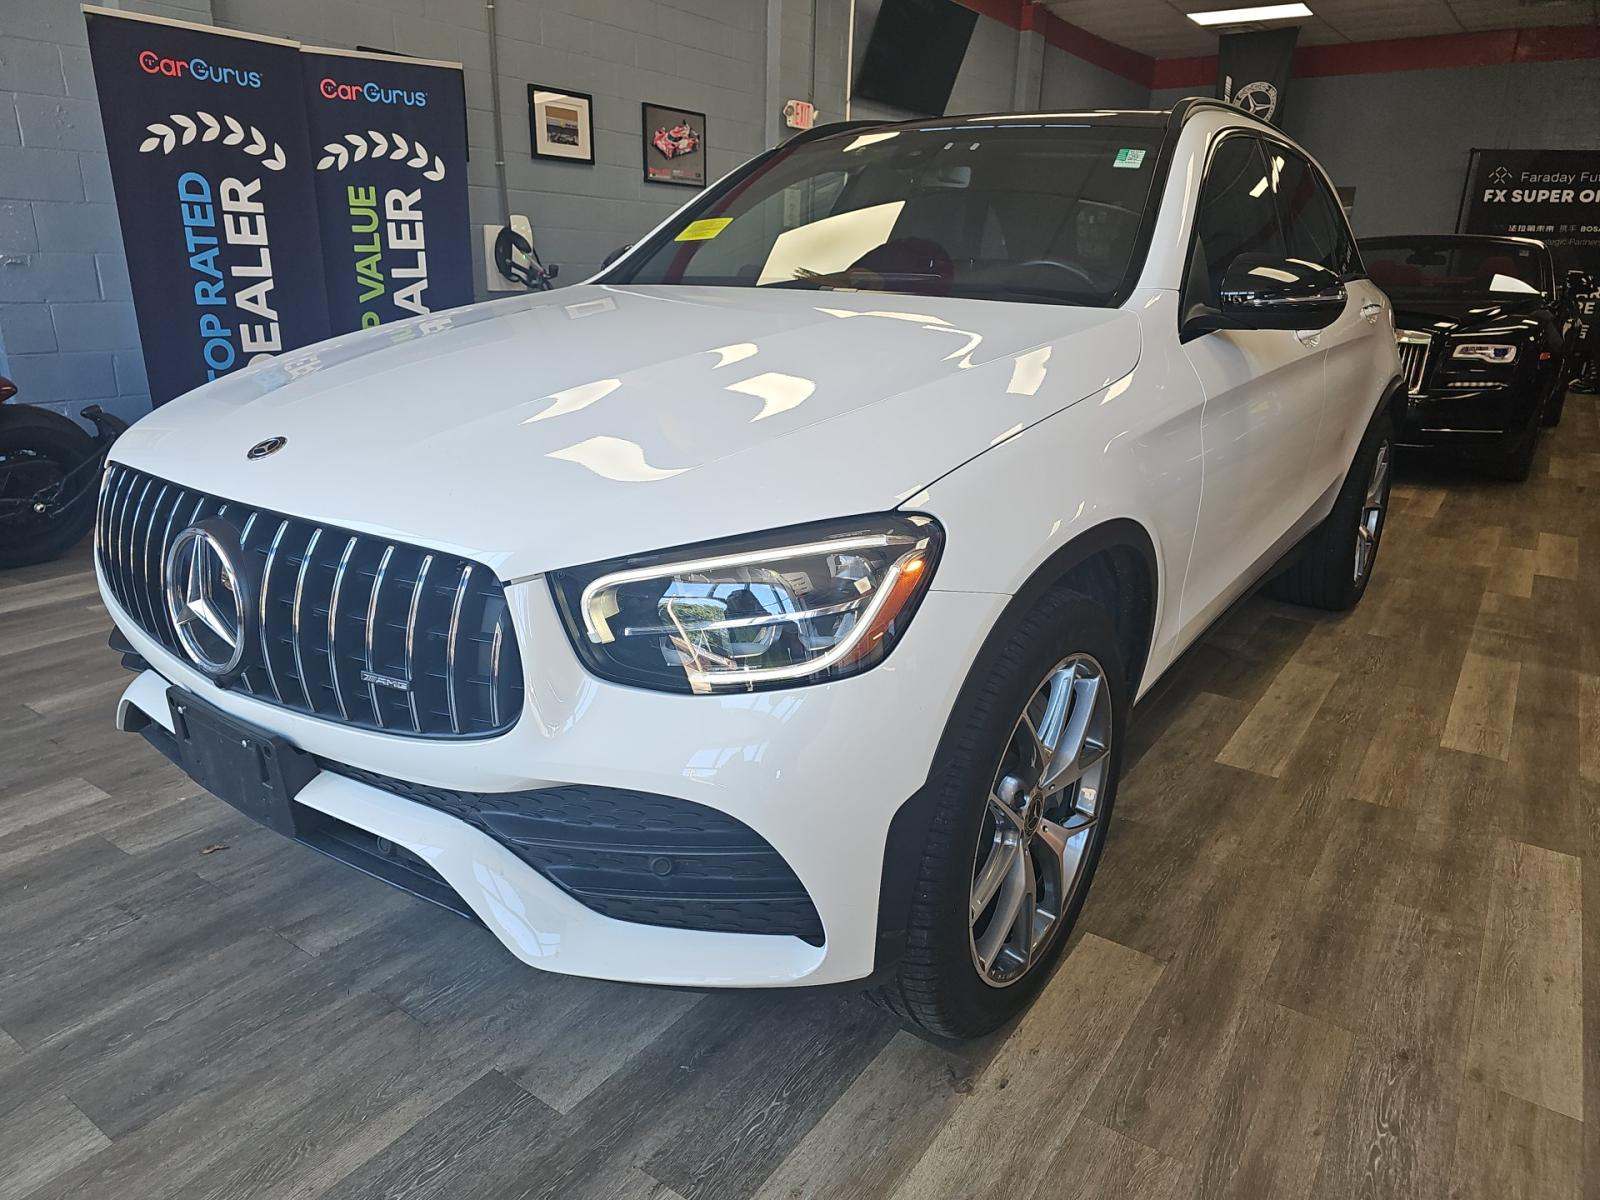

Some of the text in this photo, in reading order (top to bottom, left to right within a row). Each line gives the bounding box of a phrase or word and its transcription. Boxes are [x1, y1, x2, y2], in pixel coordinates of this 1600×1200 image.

[138, 50, 262, 89] CarGurus
[319, 77, 427, 107] CarGurus
[1483, 189, 1508, 203] FX
[1511, 189, 1575, 203] SUPER
[1521, 171, 1576, 185] Faraday
[177, 171, 227, 306] RATED
[219, 176, 283, 366] EALER
[347, 185, 385, 304] VALUE
[384, 187, 431, 316] ALER
